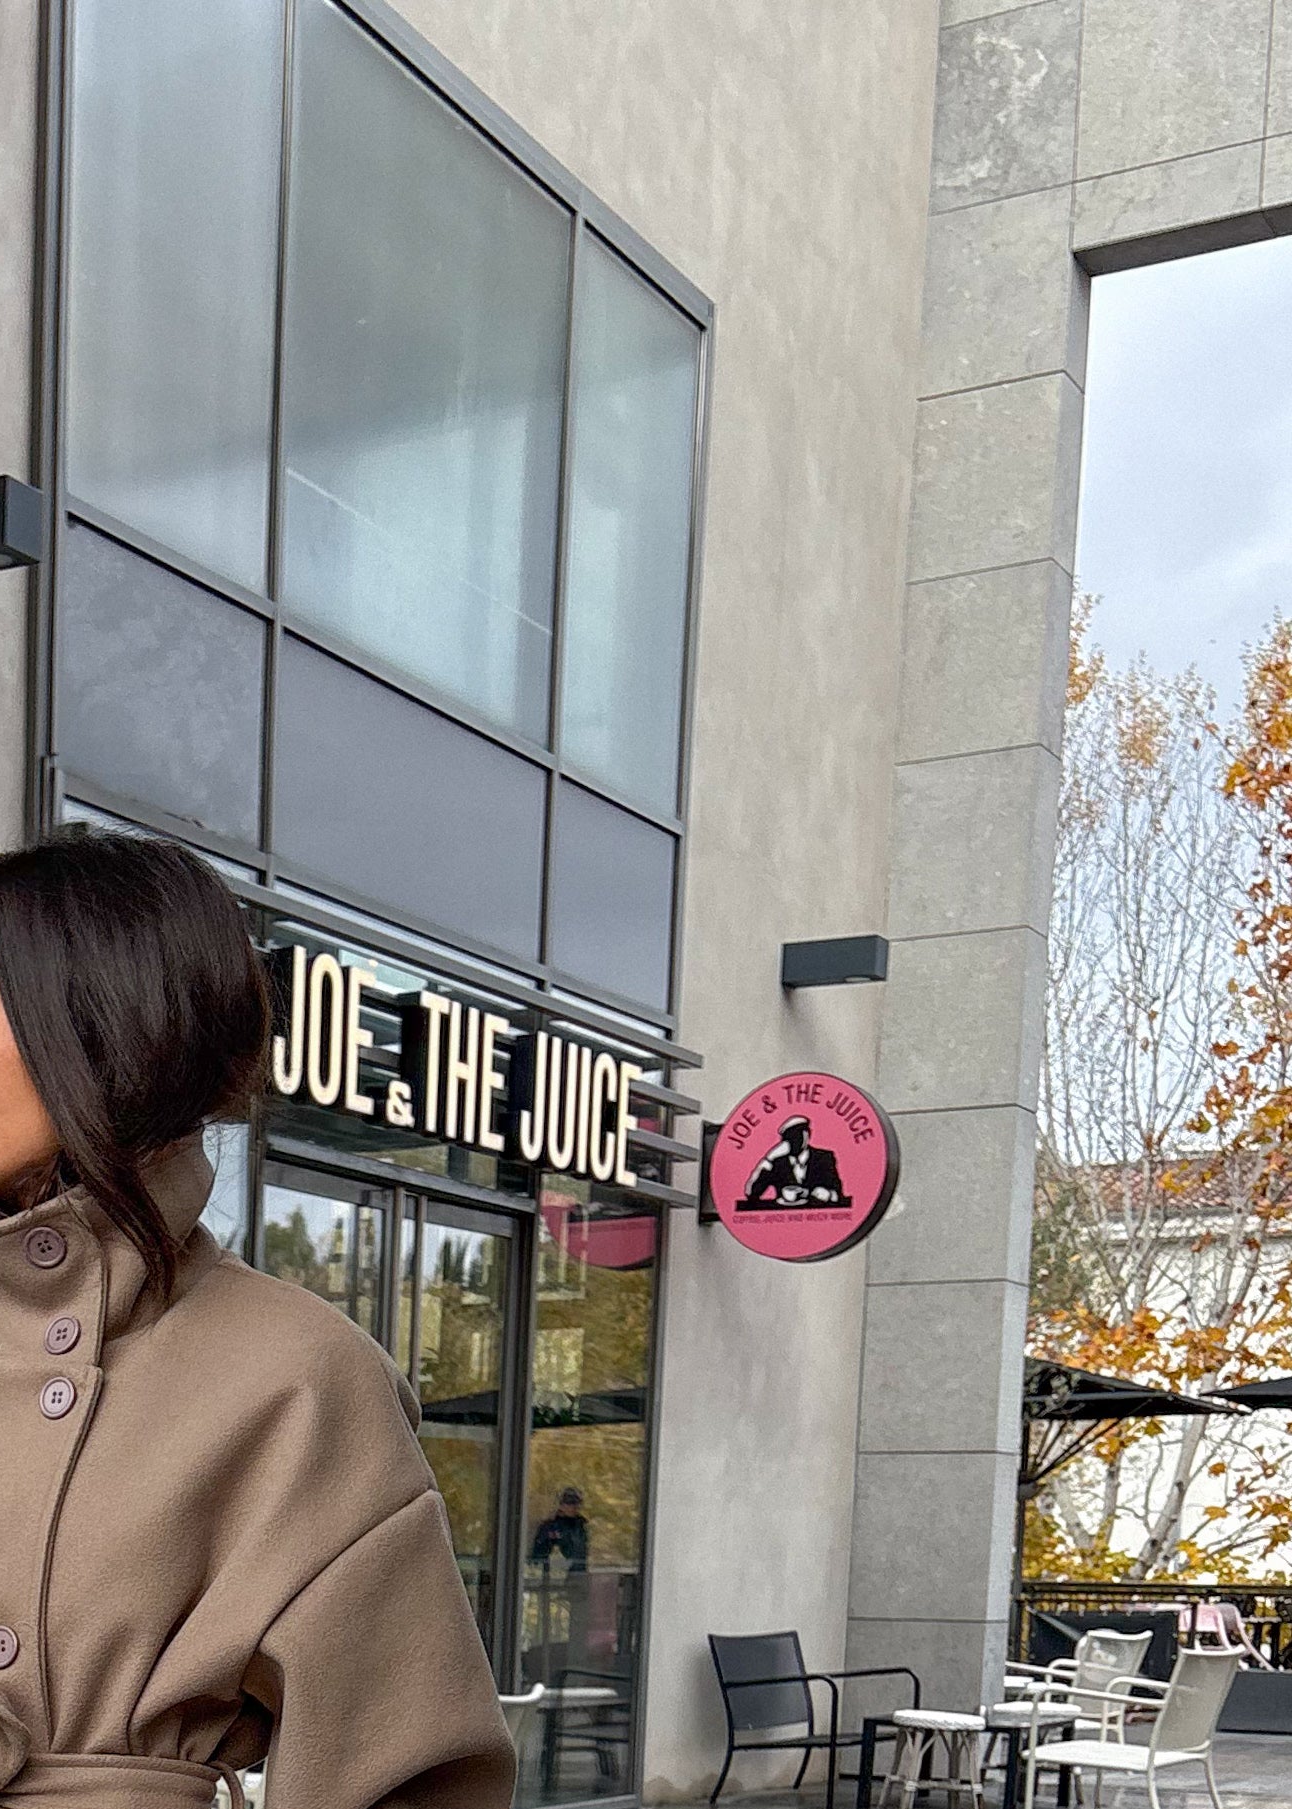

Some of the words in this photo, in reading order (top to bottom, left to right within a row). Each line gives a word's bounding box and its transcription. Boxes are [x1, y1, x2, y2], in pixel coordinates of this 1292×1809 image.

[272, 944, 376, 1116] JOE
[385, 1079, 416, 1128] &
[420, 990, 510, 1153] THE
[519, 1030, 643, 1188] JUICE
[727, 1108, 762, 1151] JOE
[761, 1094, 778, 1114] &
[781, 1082, 825, 1105] THE
[825, 1091, 876, 1145] JUICE
